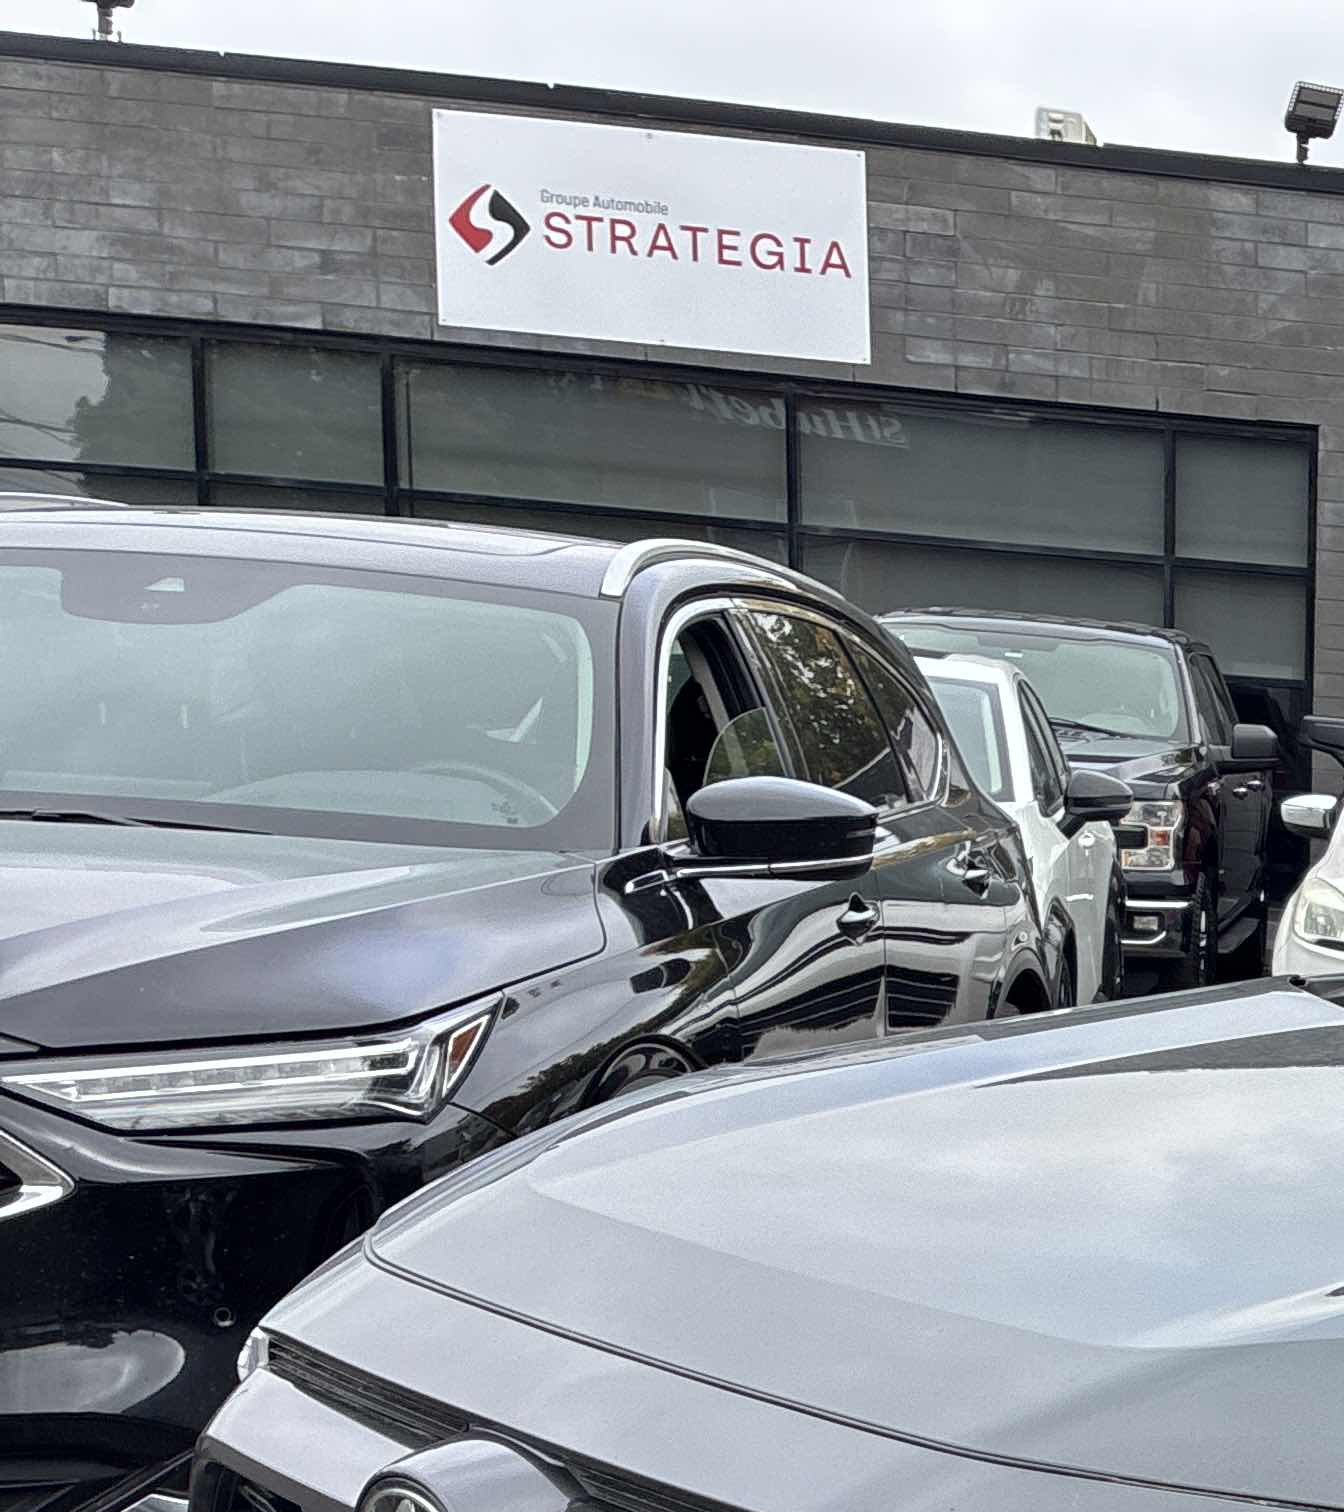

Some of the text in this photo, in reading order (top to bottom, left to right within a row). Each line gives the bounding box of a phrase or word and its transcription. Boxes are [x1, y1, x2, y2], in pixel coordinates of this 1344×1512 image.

[540, 188, 670, 216] Groupe Automobile
[543, 211, 852, 278] STRATEGIA
